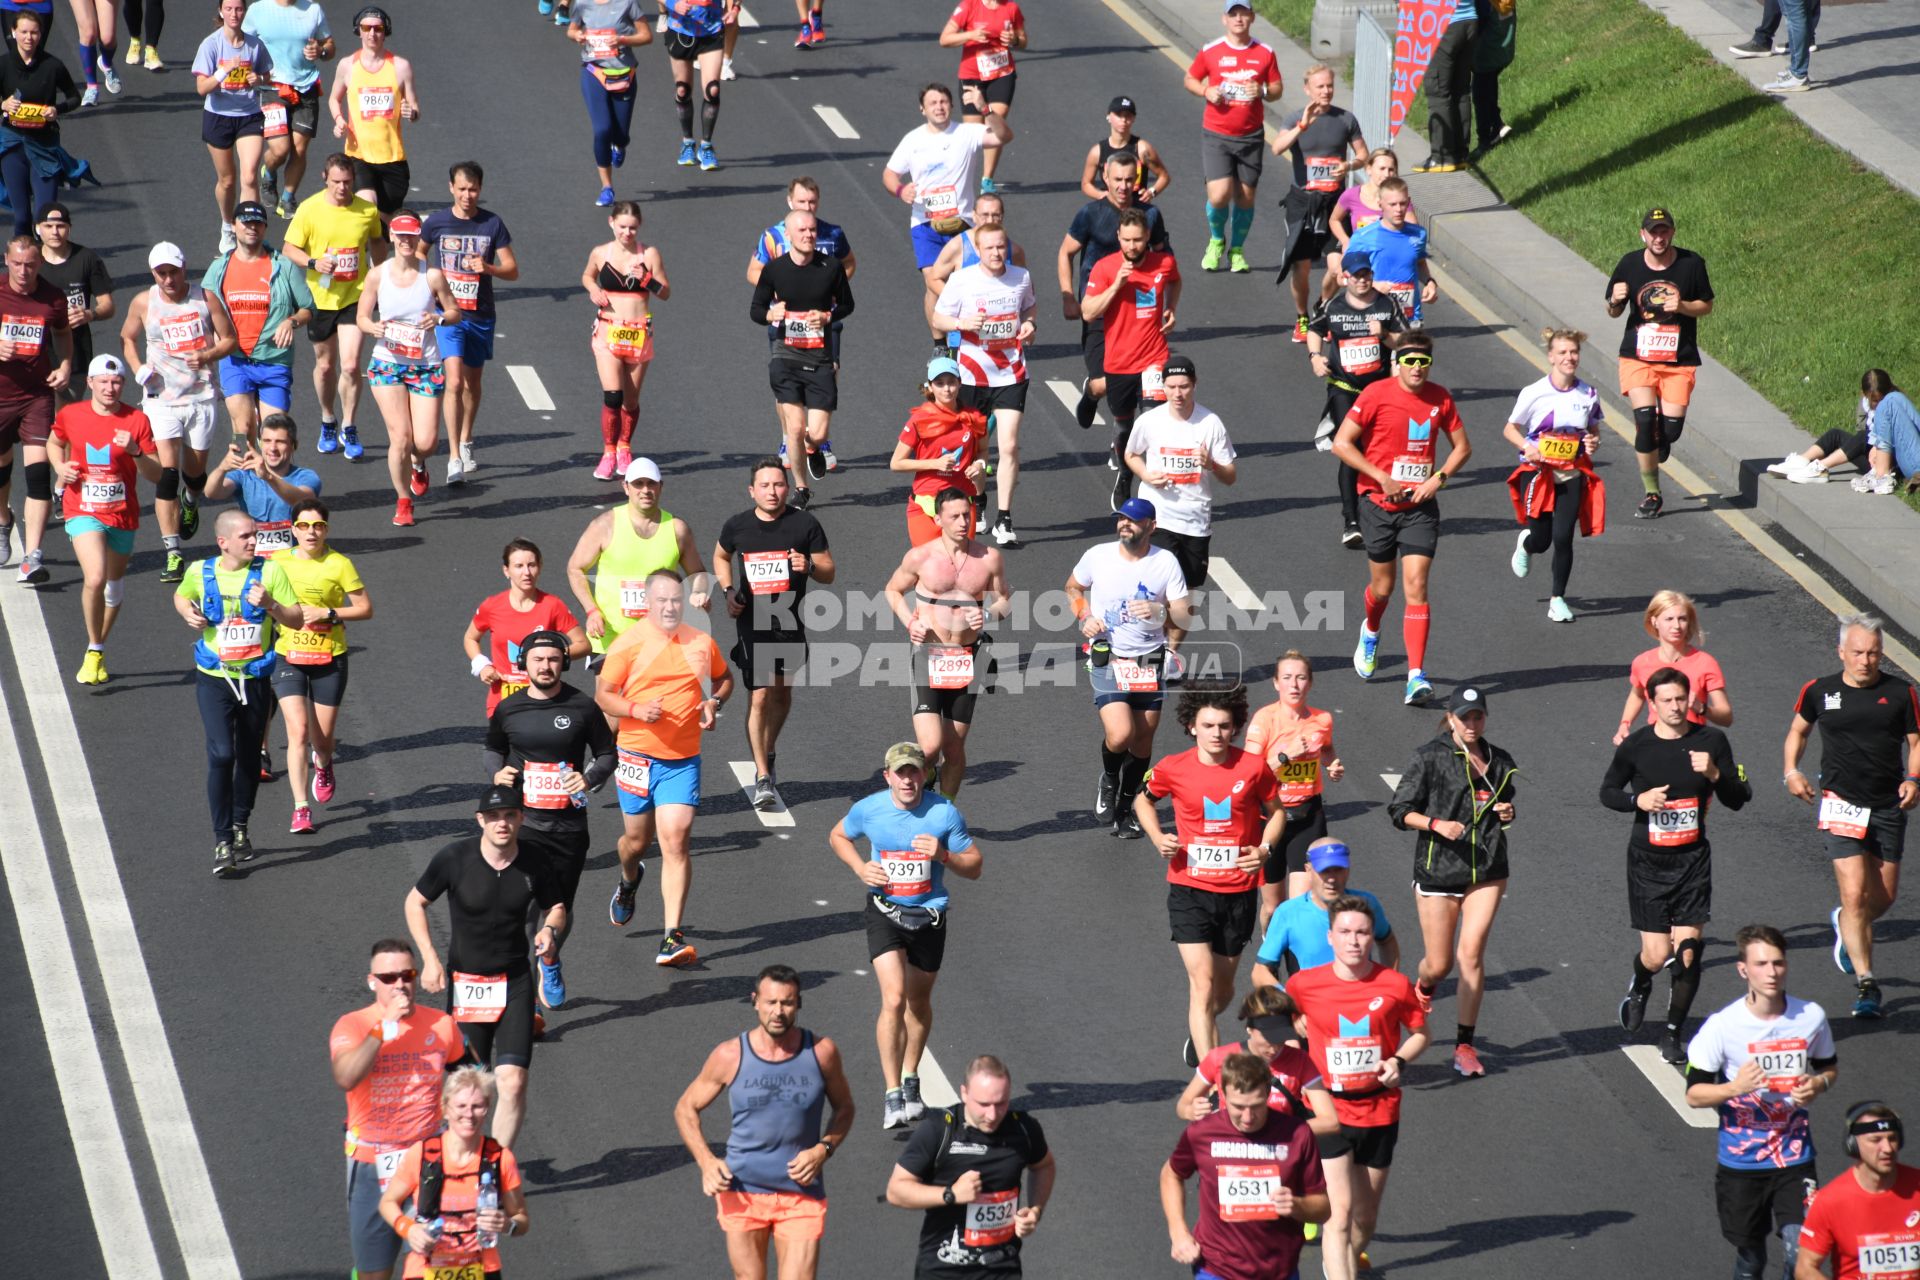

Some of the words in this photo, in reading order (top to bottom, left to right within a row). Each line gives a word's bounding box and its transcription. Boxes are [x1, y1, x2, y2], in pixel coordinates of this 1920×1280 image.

[363, 95, 390, 105] 9869
[1312, 166, 1336, 177] 791
[5, 324, 42, 339] 10408
[164, 322, 200, 339] 13511
[790, 320, 812, 333] 488
[985, 322, 1013, 335] 7038
[390, 328, 421, 344] 13846
[613, 330, 639, 341] 6800
[1643, 335, 1677, 347] 13778
[1344, 345, 1379, 360] 10100
[1545, 440, 1573, 455] 7163
[1400, 464, 1427, 477] 1128
[85, 483, 123, 497] 12584
[750, 562, 783, 576] 7574
[224, 626, 255, 641] 7017
[293, 632, 327, 646] 5367
[932, 658, 971, 672] 12899
[1119, 666, 1155, 679] 12895
[1284, 762, 1317, 777] 2017
[1828, 801, 1863, 818] 1349
[1652, 810, 1697, 826] 10929
[1196, 847, 1231, 863] 1761
[888, 862, 923, 876] 9391
[465, 985, 493, 1000] 701
[1333, 1049, 1374, 1066] 8172
[744, 1076, 797, 1089] LAGUNA
[1228, 1180, 1270, 1197] 6531
[975, 1202, 1013, 1223] 6532
[1865, 1245, 1920, 1265] 10513
